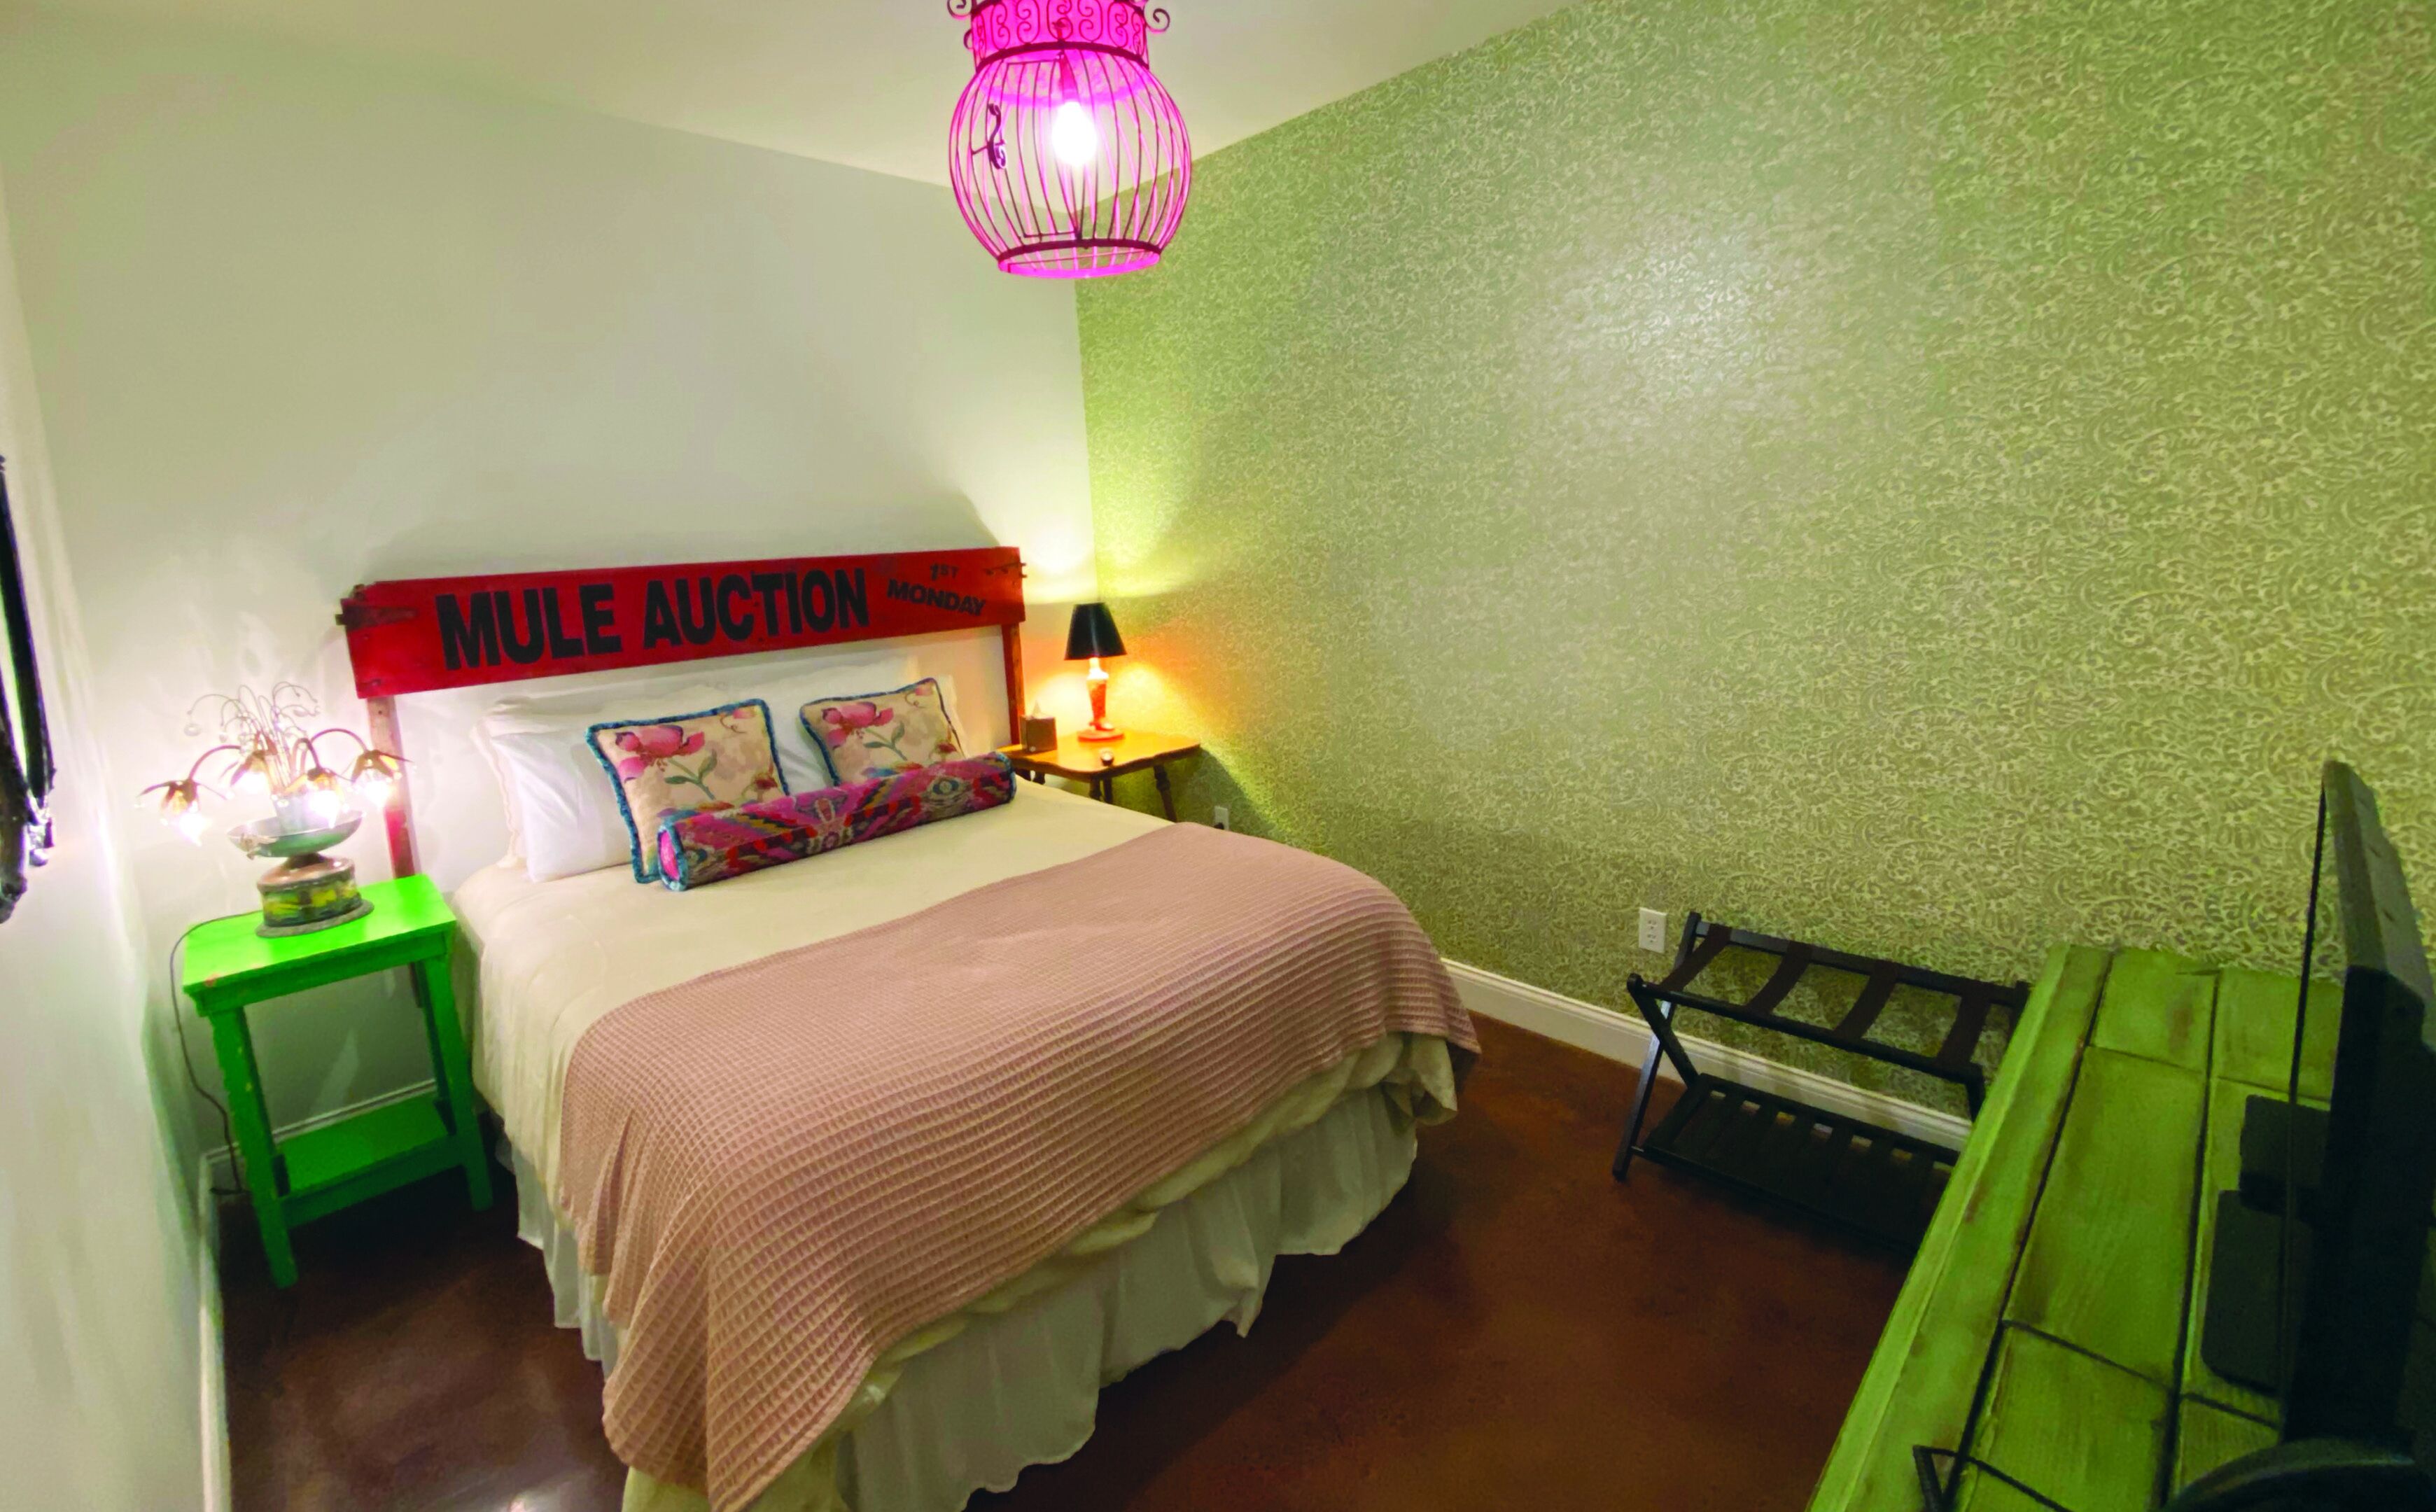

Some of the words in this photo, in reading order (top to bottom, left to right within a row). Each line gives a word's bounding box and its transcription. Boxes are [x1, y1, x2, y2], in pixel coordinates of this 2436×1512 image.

[930, 563, 959, 581] 1ST
[886, 578, 986, 617] MONDAY
[434, 584, 623, 670] MULE
[643, 567, 870, 649] AUCTION
